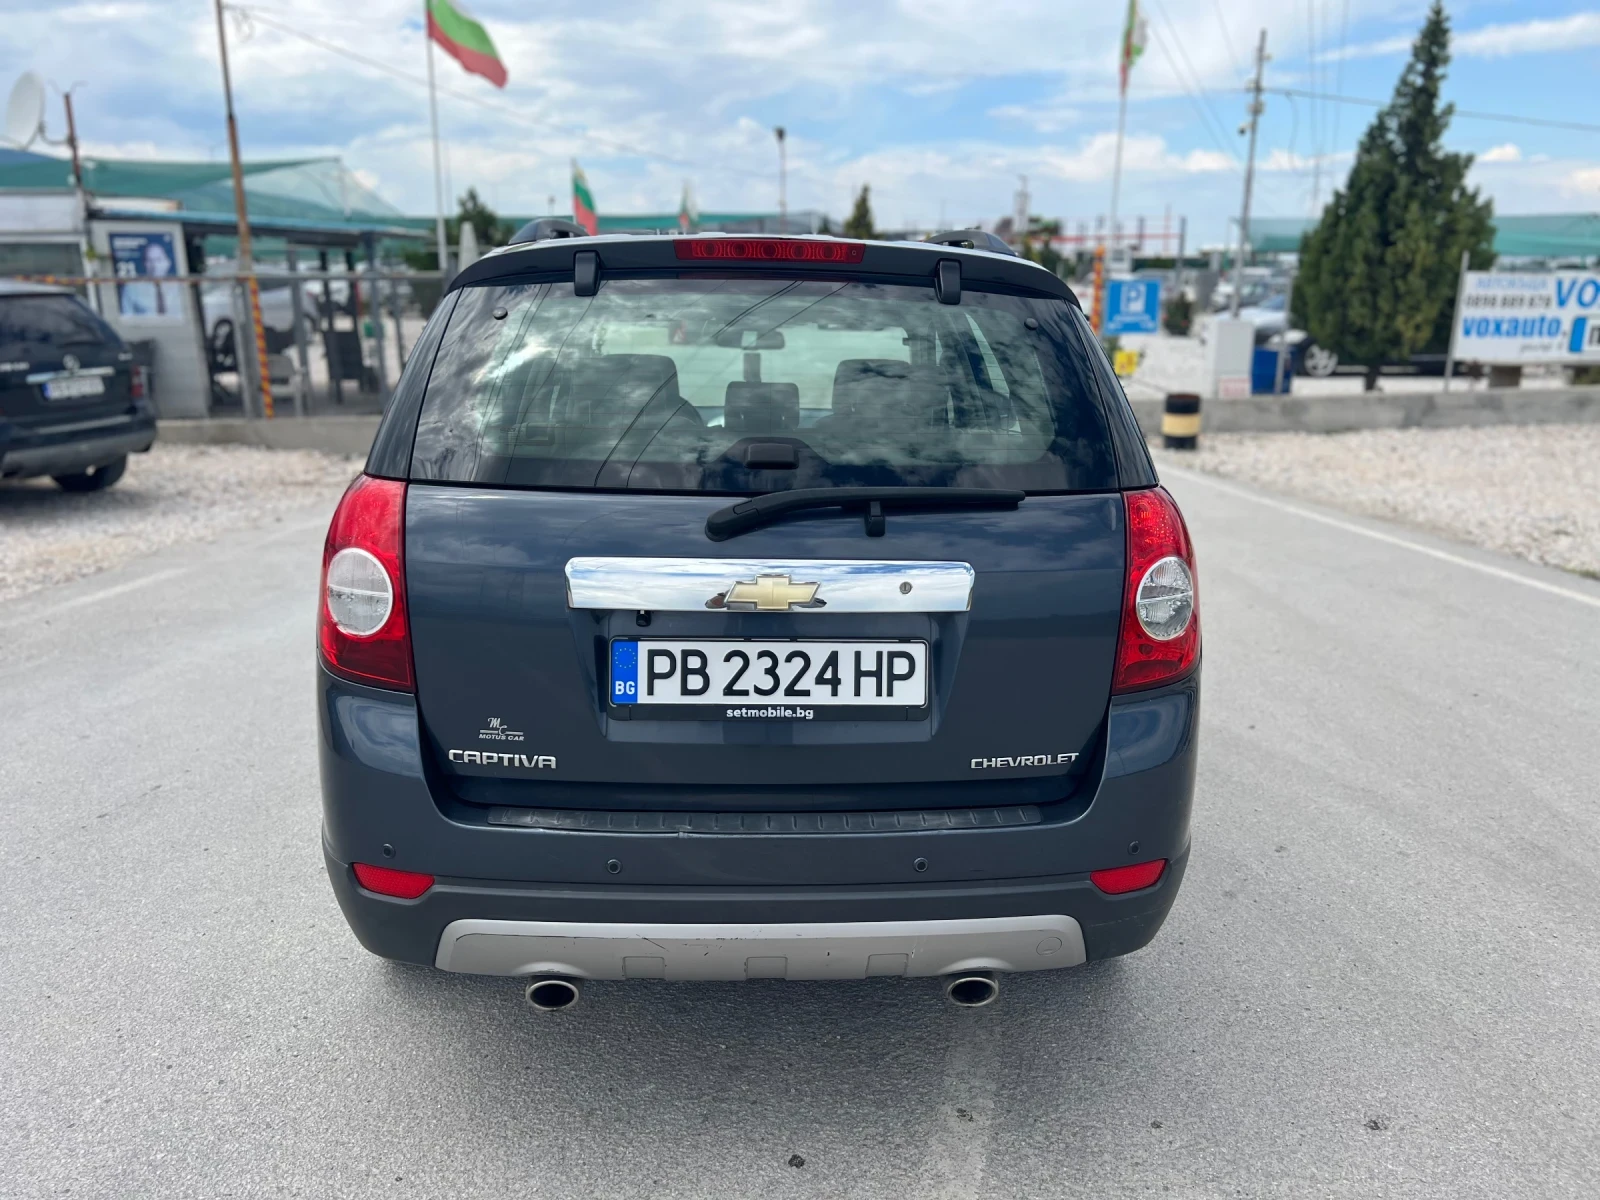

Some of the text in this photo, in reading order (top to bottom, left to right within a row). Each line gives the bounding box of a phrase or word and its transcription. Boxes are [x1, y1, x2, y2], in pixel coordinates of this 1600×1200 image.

[647, 648, 916, 697] PB 2324 HP
[615, 681, 636, 695] BG
[726, 706, 814, 720] setmobile.bg
[478, 733, 507, 741] MOTUS
[448, 749, 557, 769] CAPTIVA
[970, 752, 1080, 769] CHEVROLET
